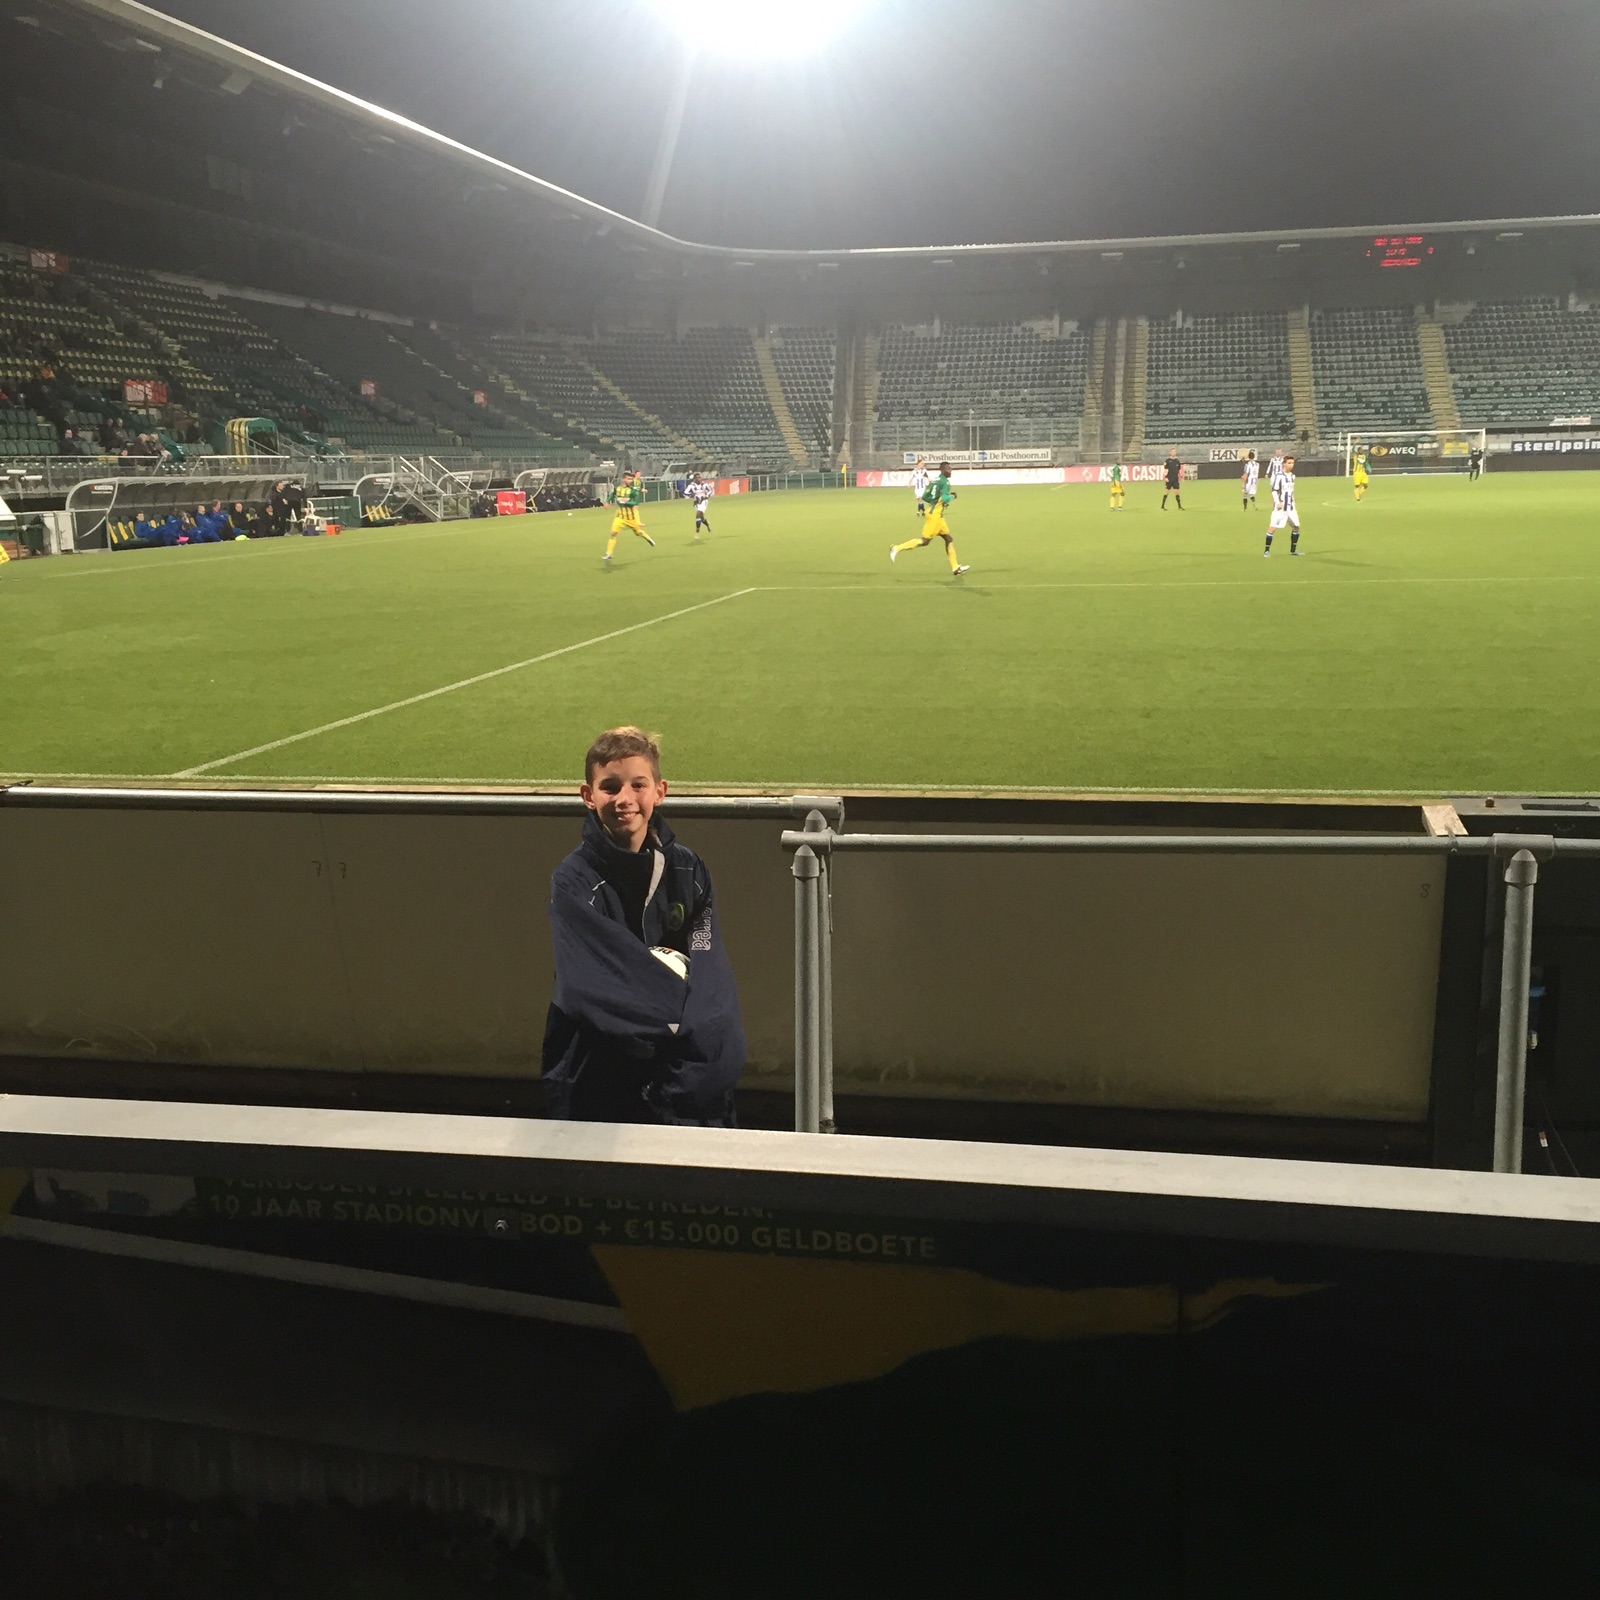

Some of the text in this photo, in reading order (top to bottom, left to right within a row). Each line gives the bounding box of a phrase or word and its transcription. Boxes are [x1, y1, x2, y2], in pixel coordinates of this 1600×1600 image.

[989, 450, 1049, 460] De Posthoorn.nl
[1388, 446, 1416, 455] AVEQ
[917, 453, 927, 462] De
[249, 1196, 322, 1218] JAAR
[332, 1200, 582, 1235] STADIONVBOD
[624, 1218, 740, 1246] €15.000
[751, 1226, 937, 1259] GELDBOETE
